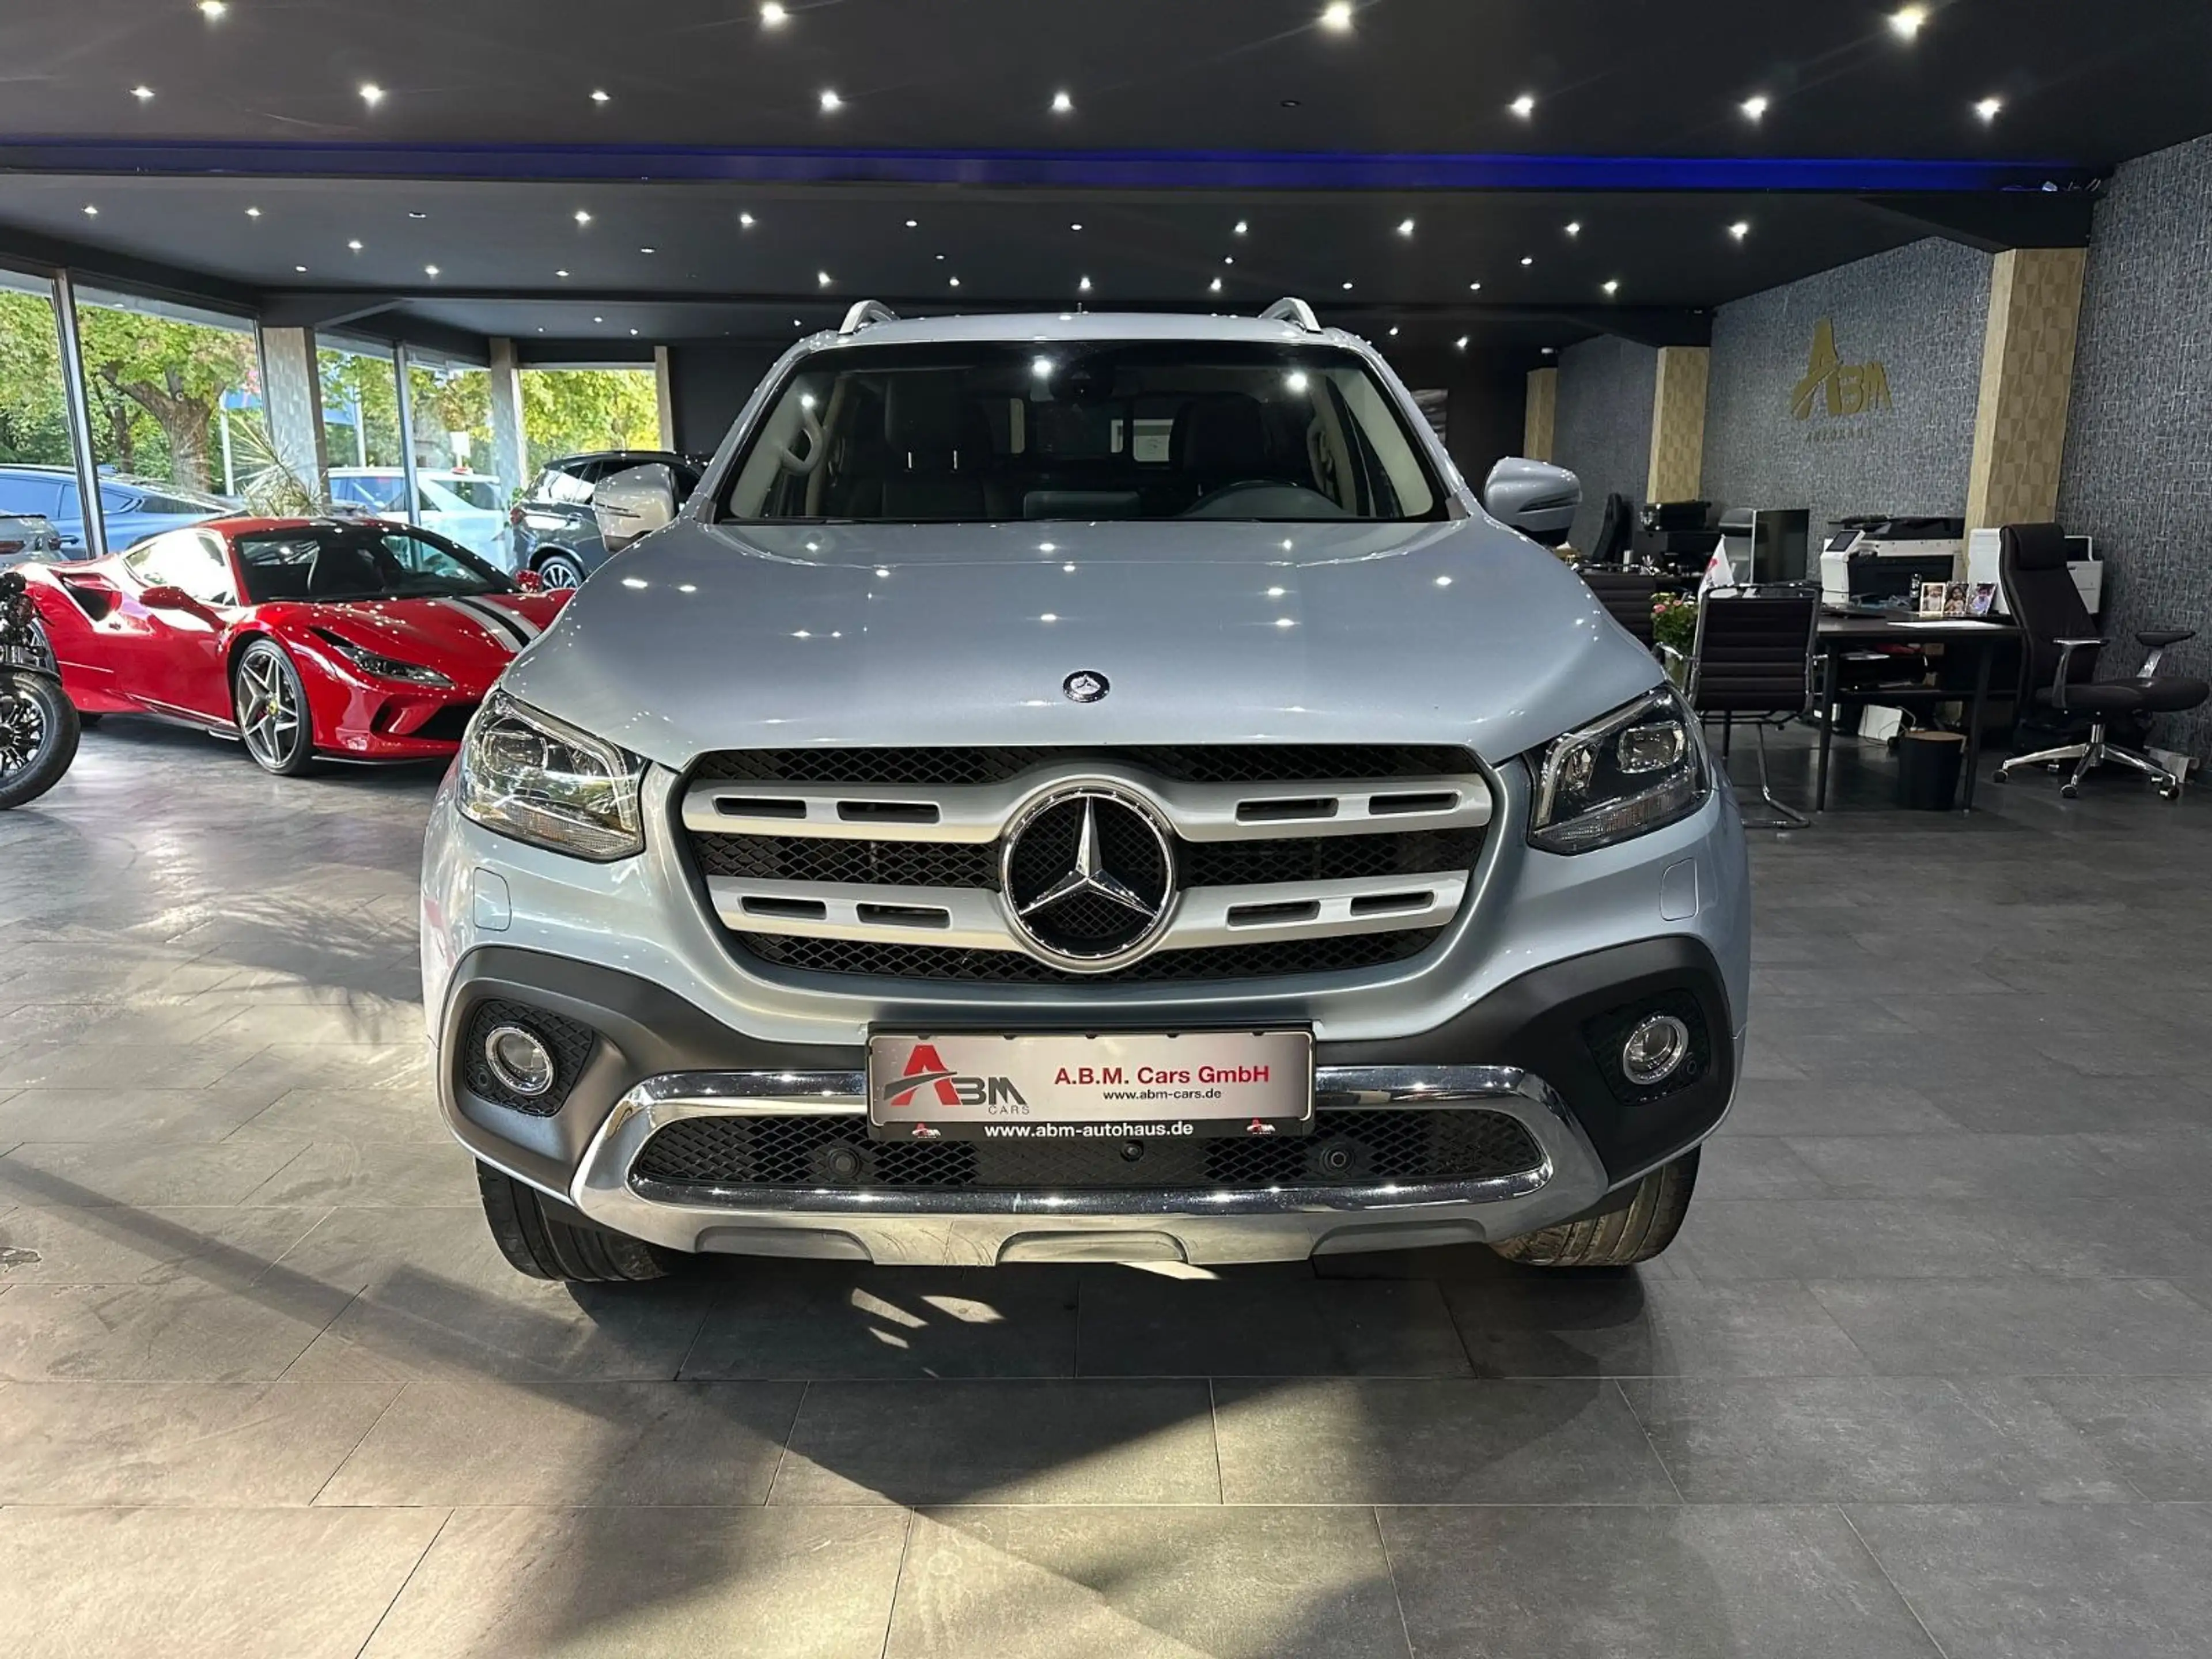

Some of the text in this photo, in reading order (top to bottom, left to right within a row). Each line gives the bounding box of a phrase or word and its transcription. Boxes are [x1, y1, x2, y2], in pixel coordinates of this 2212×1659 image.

[1791, 317, 1892, 420] ABM
[884, 1045, 1027, 1105] ABM
[1054, 1065, 1270, 1085] A.B.M. Cars GmbH
[1103, 1088, 1222, 1100] www.abm-cars.de
[988, 1105, 1030, 1115] CARS
[984, 1121, 1194, 1138] www.abm-autohaus.de
